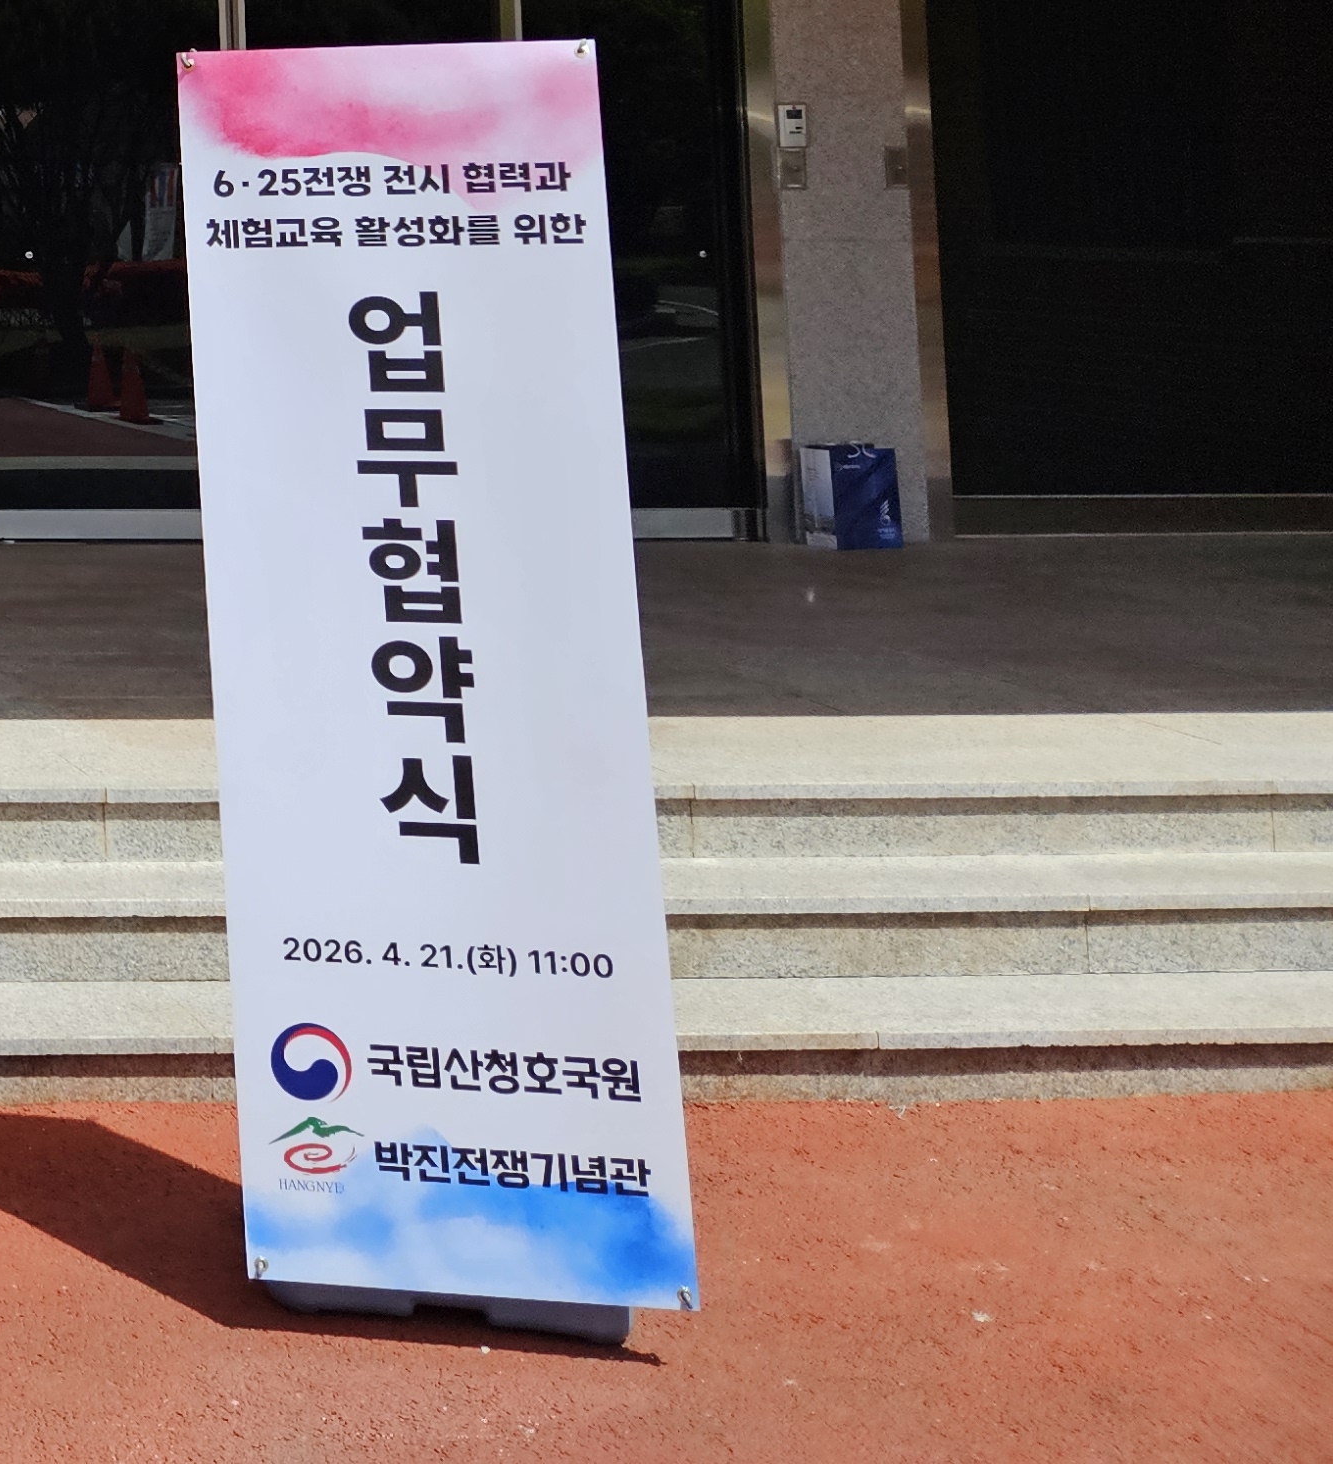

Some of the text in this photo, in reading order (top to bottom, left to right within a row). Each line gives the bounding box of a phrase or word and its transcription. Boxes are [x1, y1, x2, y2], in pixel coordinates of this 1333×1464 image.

[213, 161, 572, 198] 6·25전쟁 전시 협력과
[206, 212, 587, 250] 체험교육 활성화를 위한
[347, 290, 481, 866] 업무협약식
[282, 937, 615, 979] 2026. 4. 21.(화) 11:00
[366, 1043, 643, 1103] 국립산청호국원
[373, 1140, 652, 1198] 박진전쟁기념관
